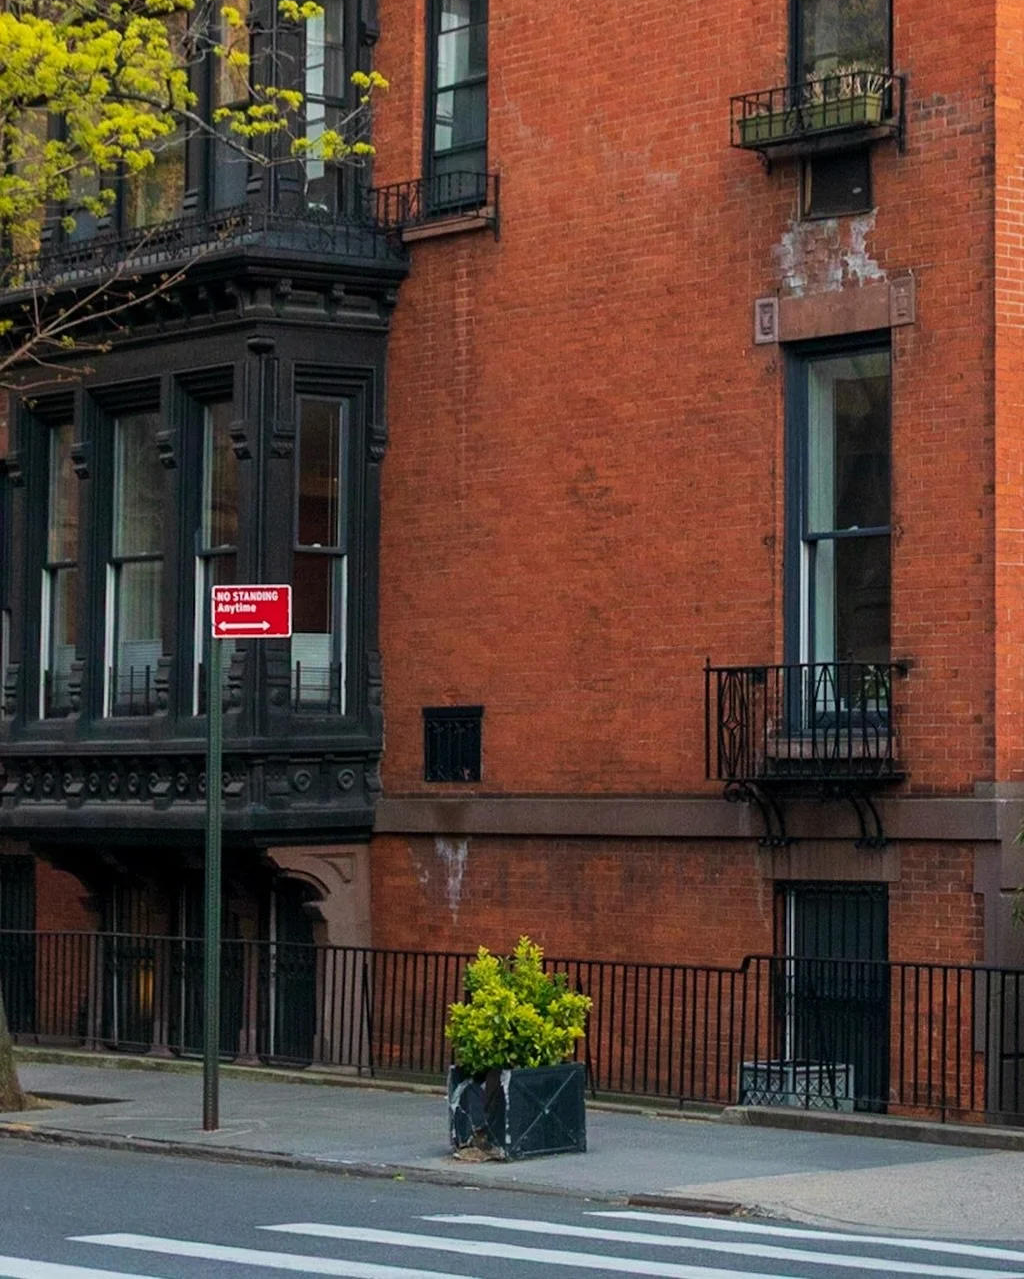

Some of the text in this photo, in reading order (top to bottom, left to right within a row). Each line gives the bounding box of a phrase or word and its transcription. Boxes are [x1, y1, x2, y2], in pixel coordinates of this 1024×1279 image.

[216, 591, 279, 602] NO STANDING
[217, 602, 257, 614] Anytime
